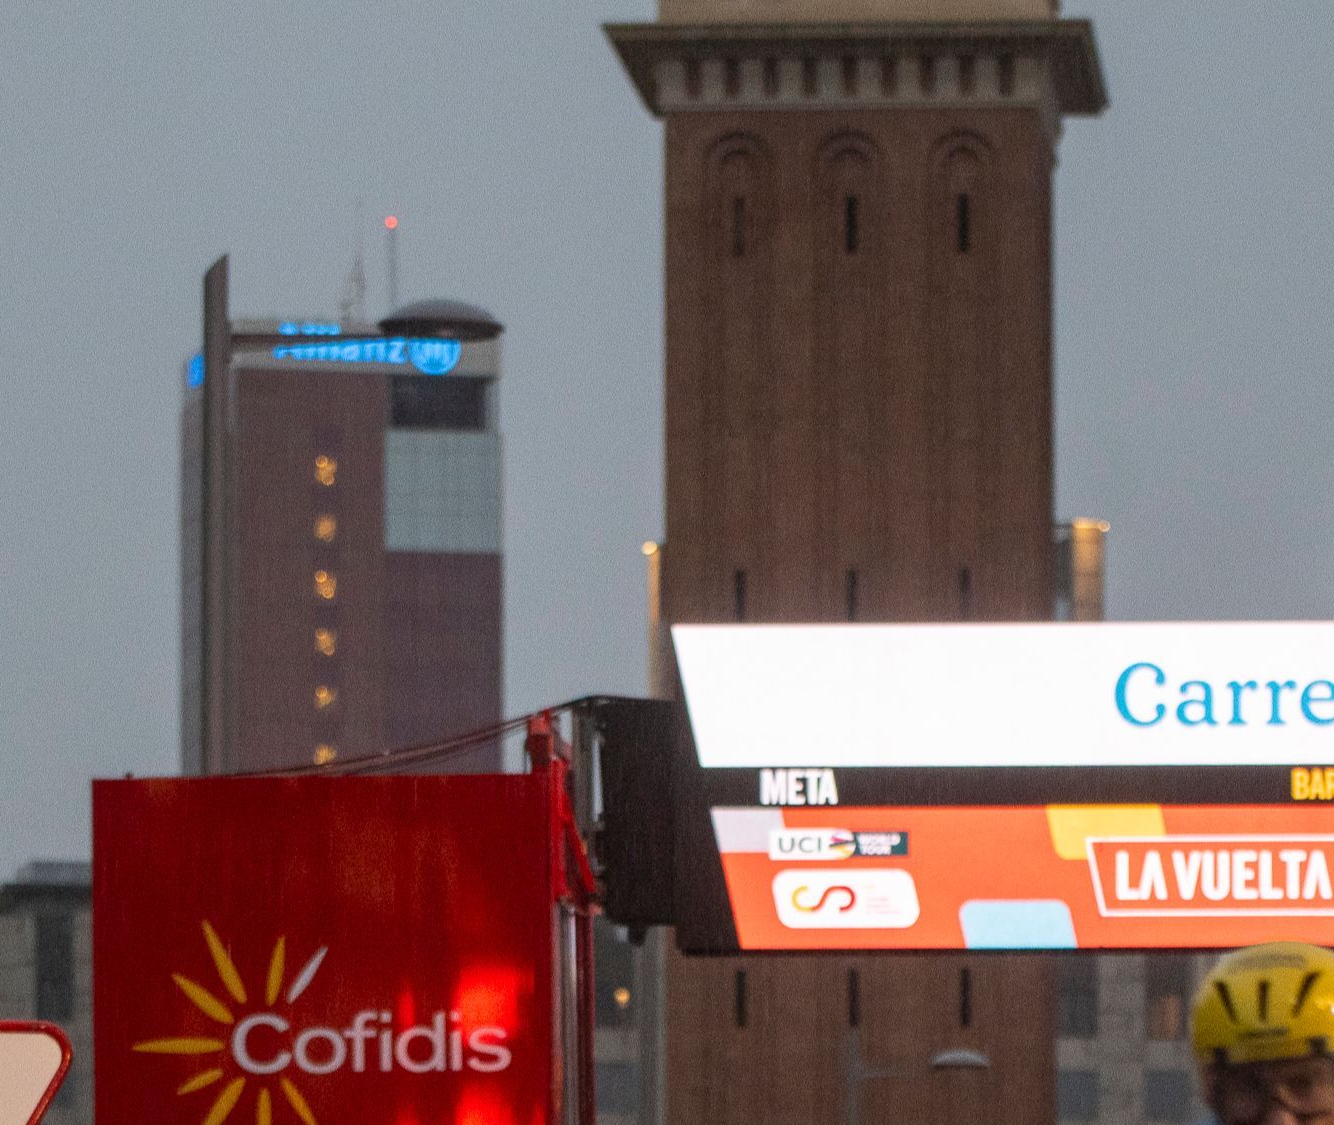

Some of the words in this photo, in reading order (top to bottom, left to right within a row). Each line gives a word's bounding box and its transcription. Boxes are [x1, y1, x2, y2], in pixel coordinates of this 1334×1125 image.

[760, 768, 839, 806] META
[778, 836, 822, 854] UCI
[1115, 851, 1168, 902] LA
[1171, 850, 1334, 902] VUELTA
[229, 1011, 512, 1076] Cofidis
